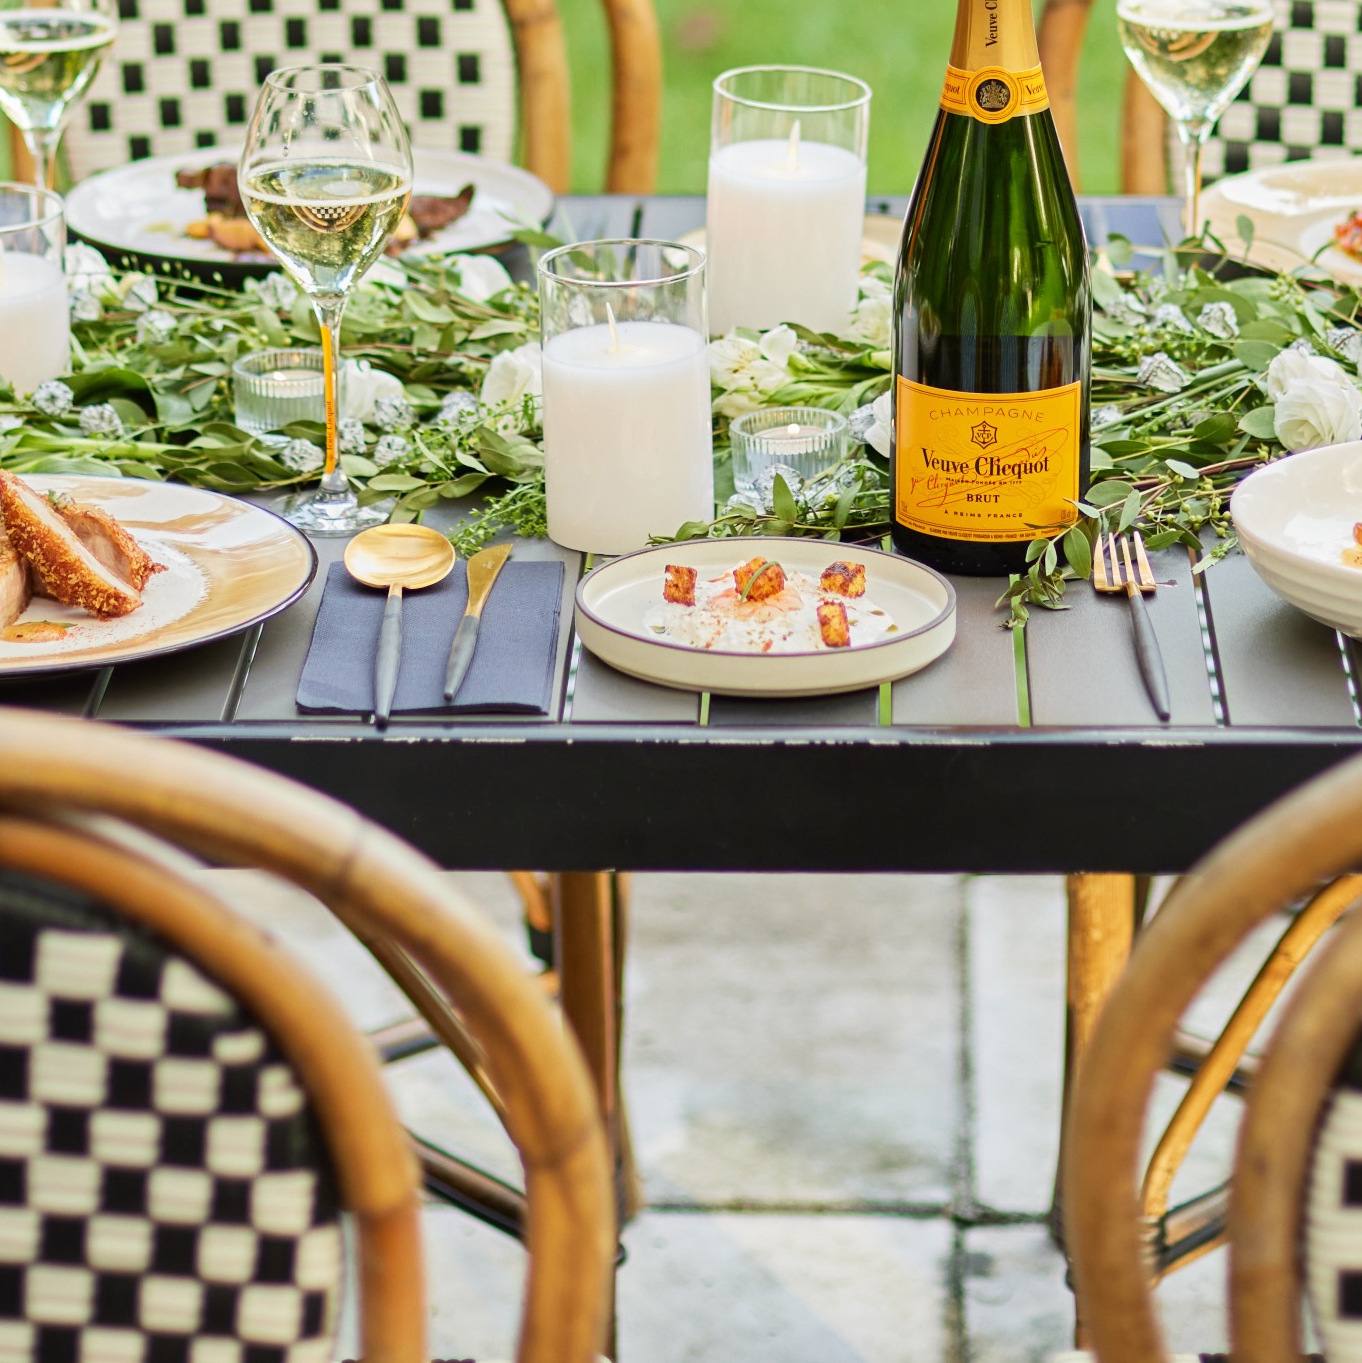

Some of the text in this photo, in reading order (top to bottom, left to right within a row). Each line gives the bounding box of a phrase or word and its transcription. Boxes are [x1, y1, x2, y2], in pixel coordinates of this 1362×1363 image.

[985, 13, 998, 48] Veuve
[945, 83, 961, 95] quot
[1025, 83, 1044, 96] Veuv
[929, 406, 1044, 422] CHAMPAGNE
[921, 447, 969, 475] Veuve
[974, 456, 1049, 480] Clicquot
[966, 493, 1000, 503] BRUT
